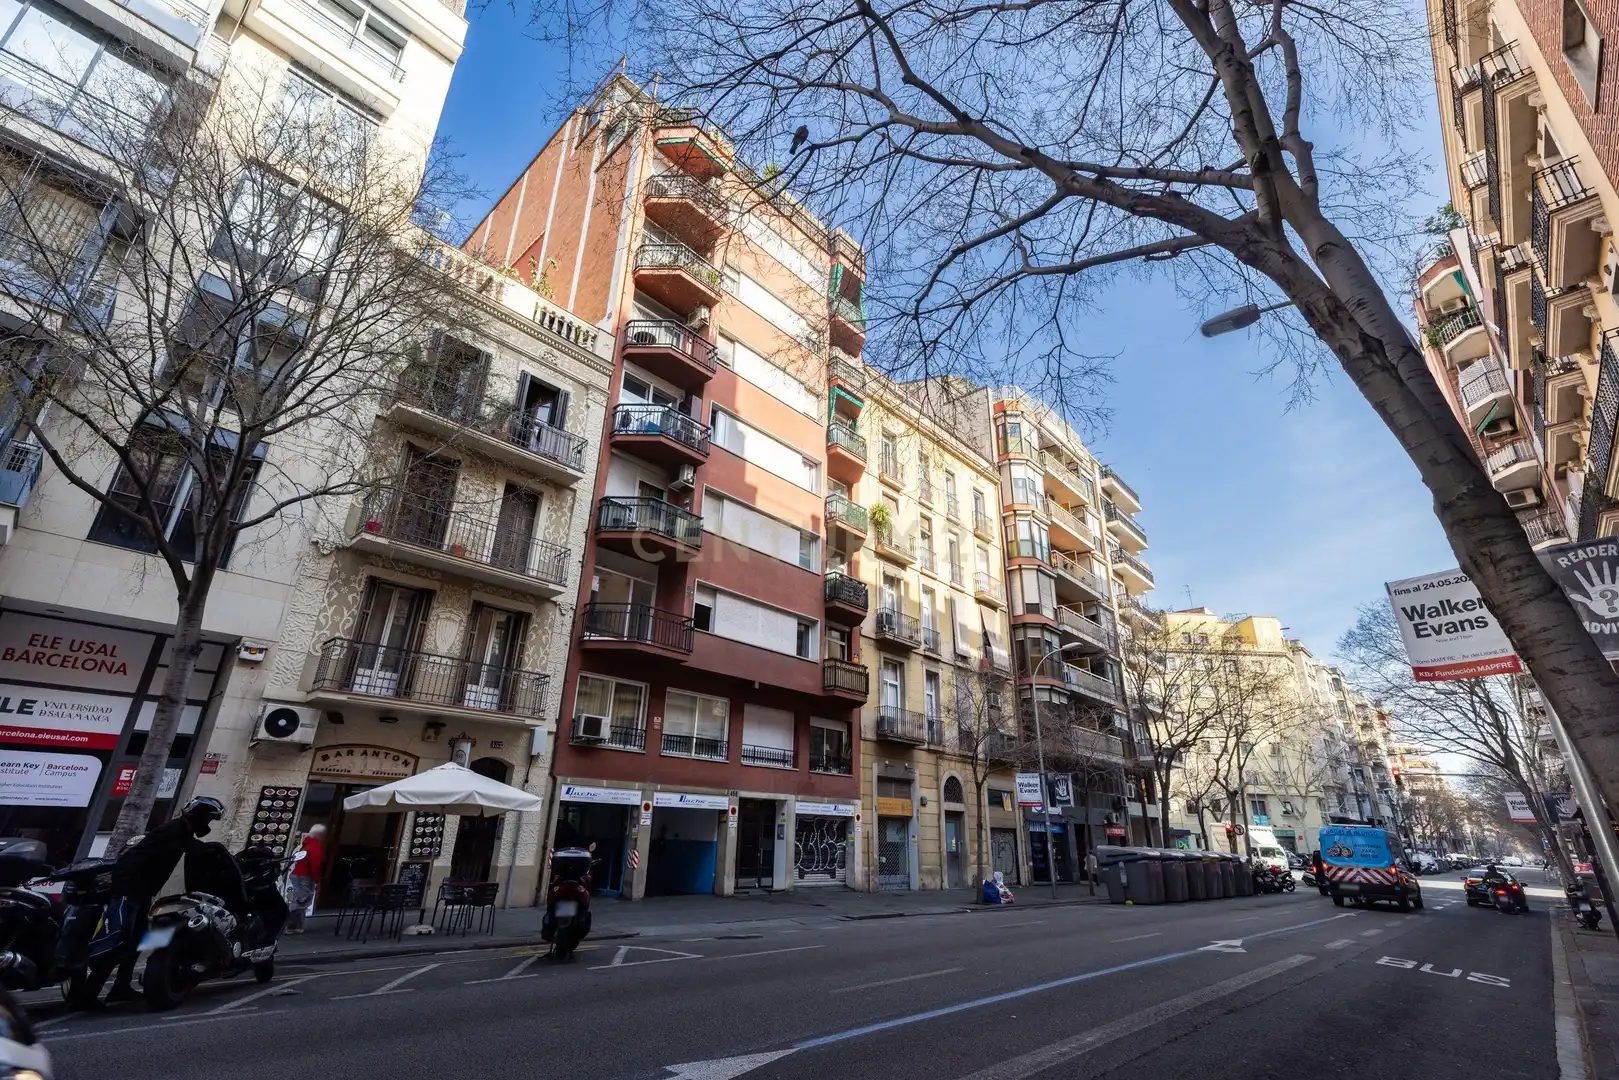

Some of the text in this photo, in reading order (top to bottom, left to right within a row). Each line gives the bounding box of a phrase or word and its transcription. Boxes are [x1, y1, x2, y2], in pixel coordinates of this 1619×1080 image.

[1557, 544, 1619, 568] READER
[1393, 576, 1471, 596] fins al 24.05.20
[1401, 597, 1484, 622] Walker
[1412, 615, 1489, 638] Evans
[28, 633, 118, 658] ELE USAL
[2, 647, 128, 676] BARCELONA
[1435, 666, 1476, 677] Fundación
[1477, 661, 1514, 672] MAPFRE
[0, 696, 38, 716] LE
[23, 762, 40, 770] Key
[47, 763, 88, 772] Barcelona
[321, 749, 412, 768] BARANTON
[0, 767, 77, 778] stitute Campus
[1375, 956, 1511, 988] BUS
